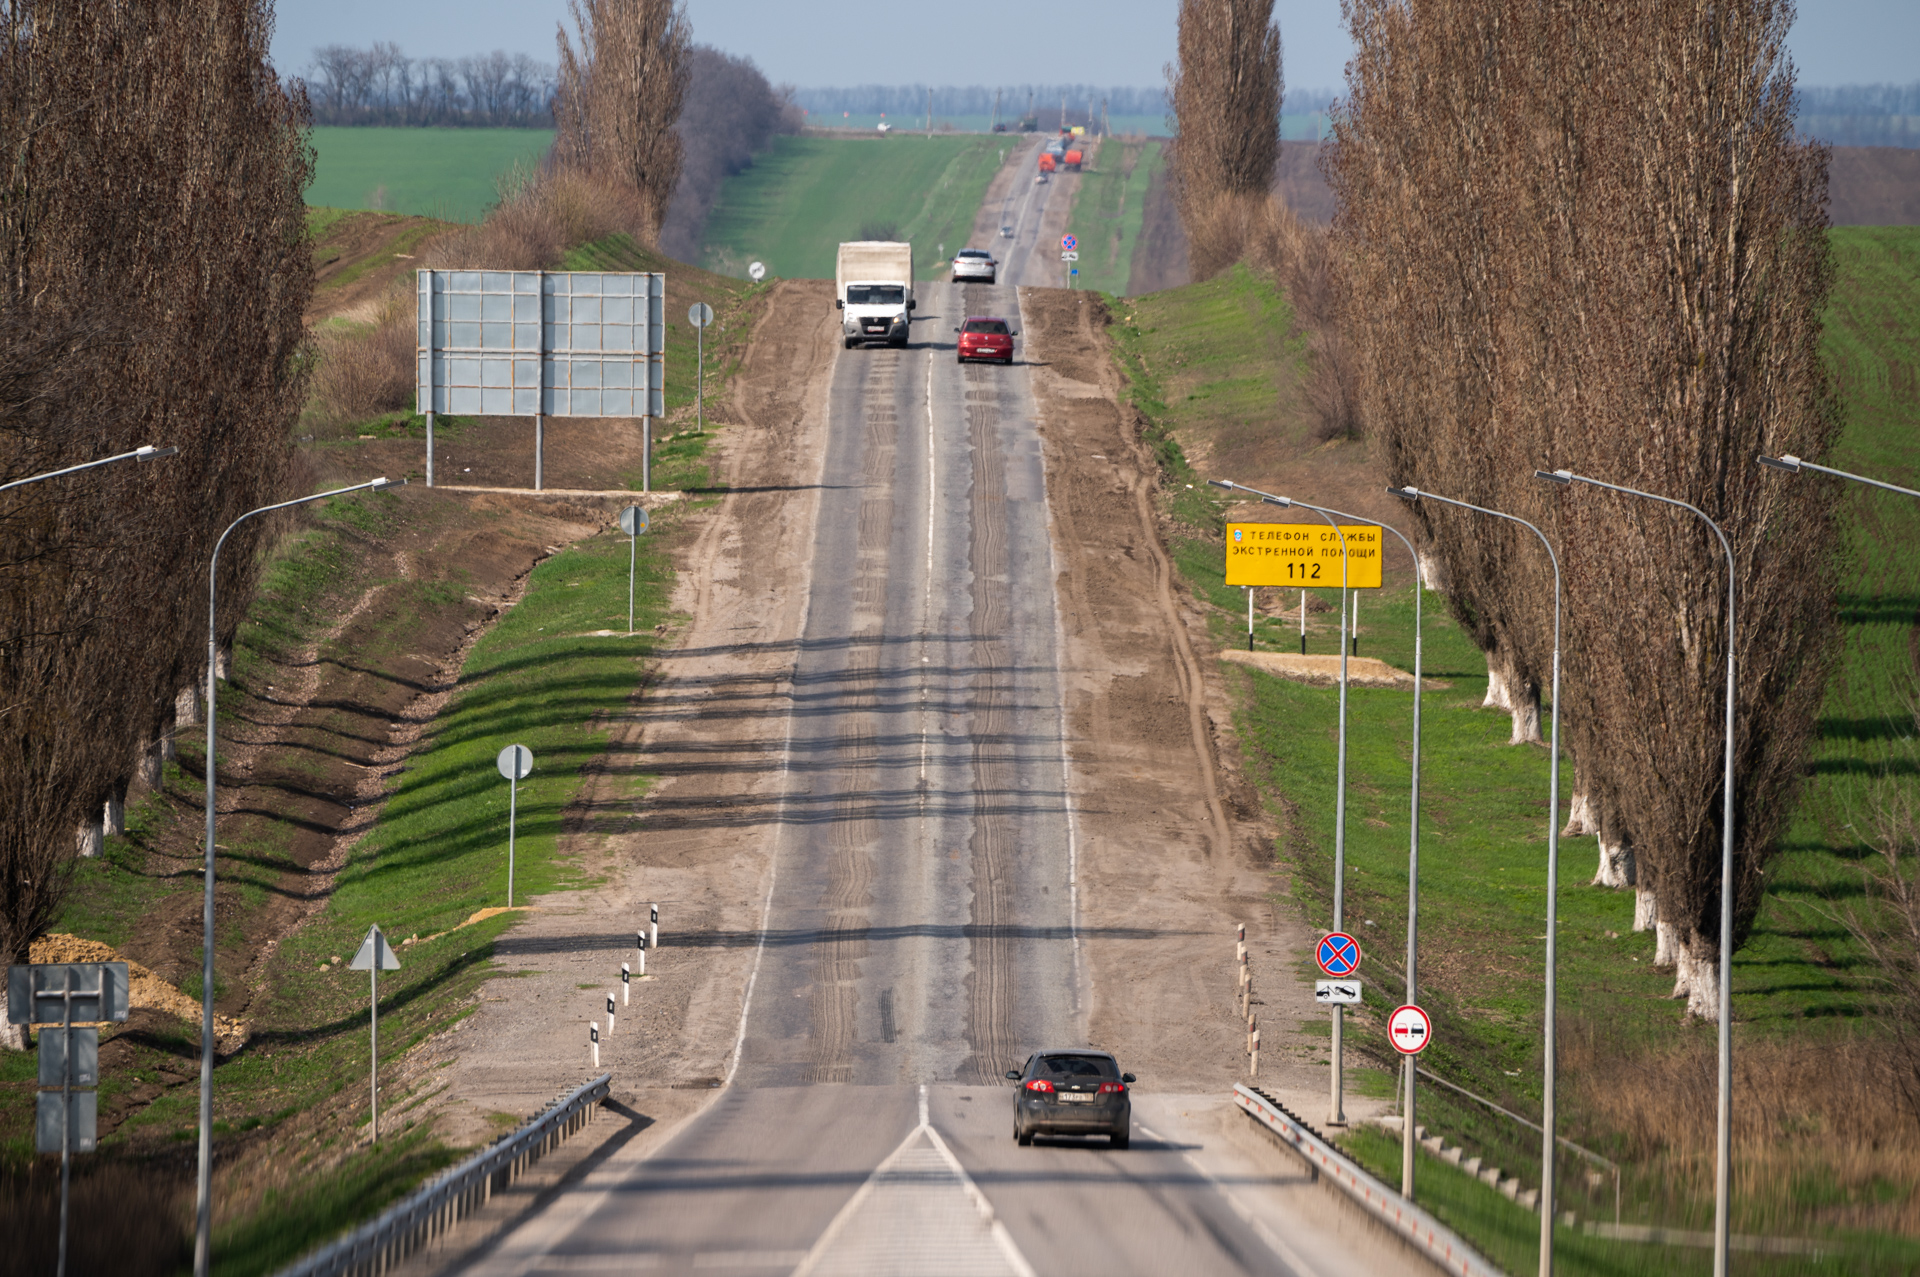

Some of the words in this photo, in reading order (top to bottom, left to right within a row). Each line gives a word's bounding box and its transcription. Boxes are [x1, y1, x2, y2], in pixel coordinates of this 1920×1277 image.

[1250, 531, 1309, 541] ТЕЛЕФОН
[1232, 546, 1314, 557] ЭКСТРЕННОЙ
[1287, 562, 1321, 579] 112
